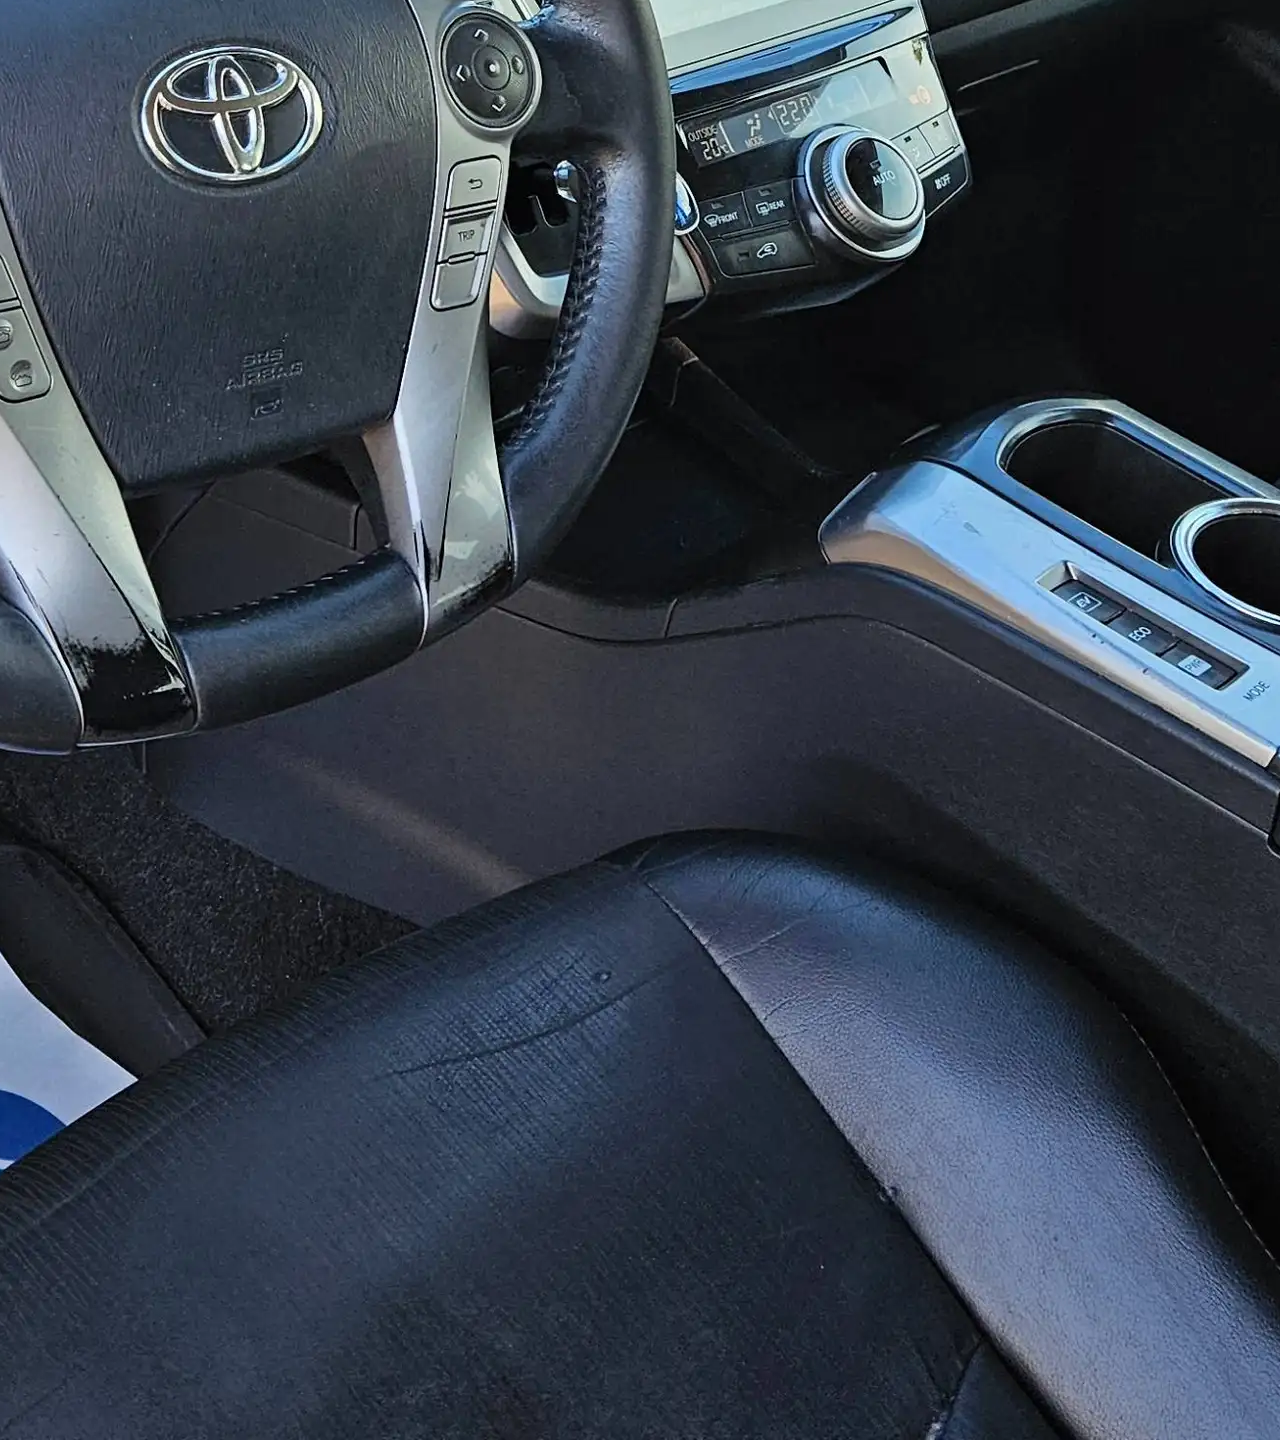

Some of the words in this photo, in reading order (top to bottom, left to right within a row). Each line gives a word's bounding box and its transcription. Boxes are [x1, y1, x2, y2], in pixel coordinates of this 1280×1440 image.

[687, 124, 718, 142] OUTSIDE
[744, 134, 766, 150] MODE
[872, 170, 896, 187] AUTO
[768, 200, 786, 212] REAR
[718, 211, 739, 225] FRONT
[458, 229, 475, 242] TRIP
[243, 348, 283, 368] SRS
[224, 361, 303, 392] AIRBAG
[1128, 626, 1153, 644] ECO
[1184, 657, 1203, 673] PWR
[1242, 679, 1272, 703] MODE
